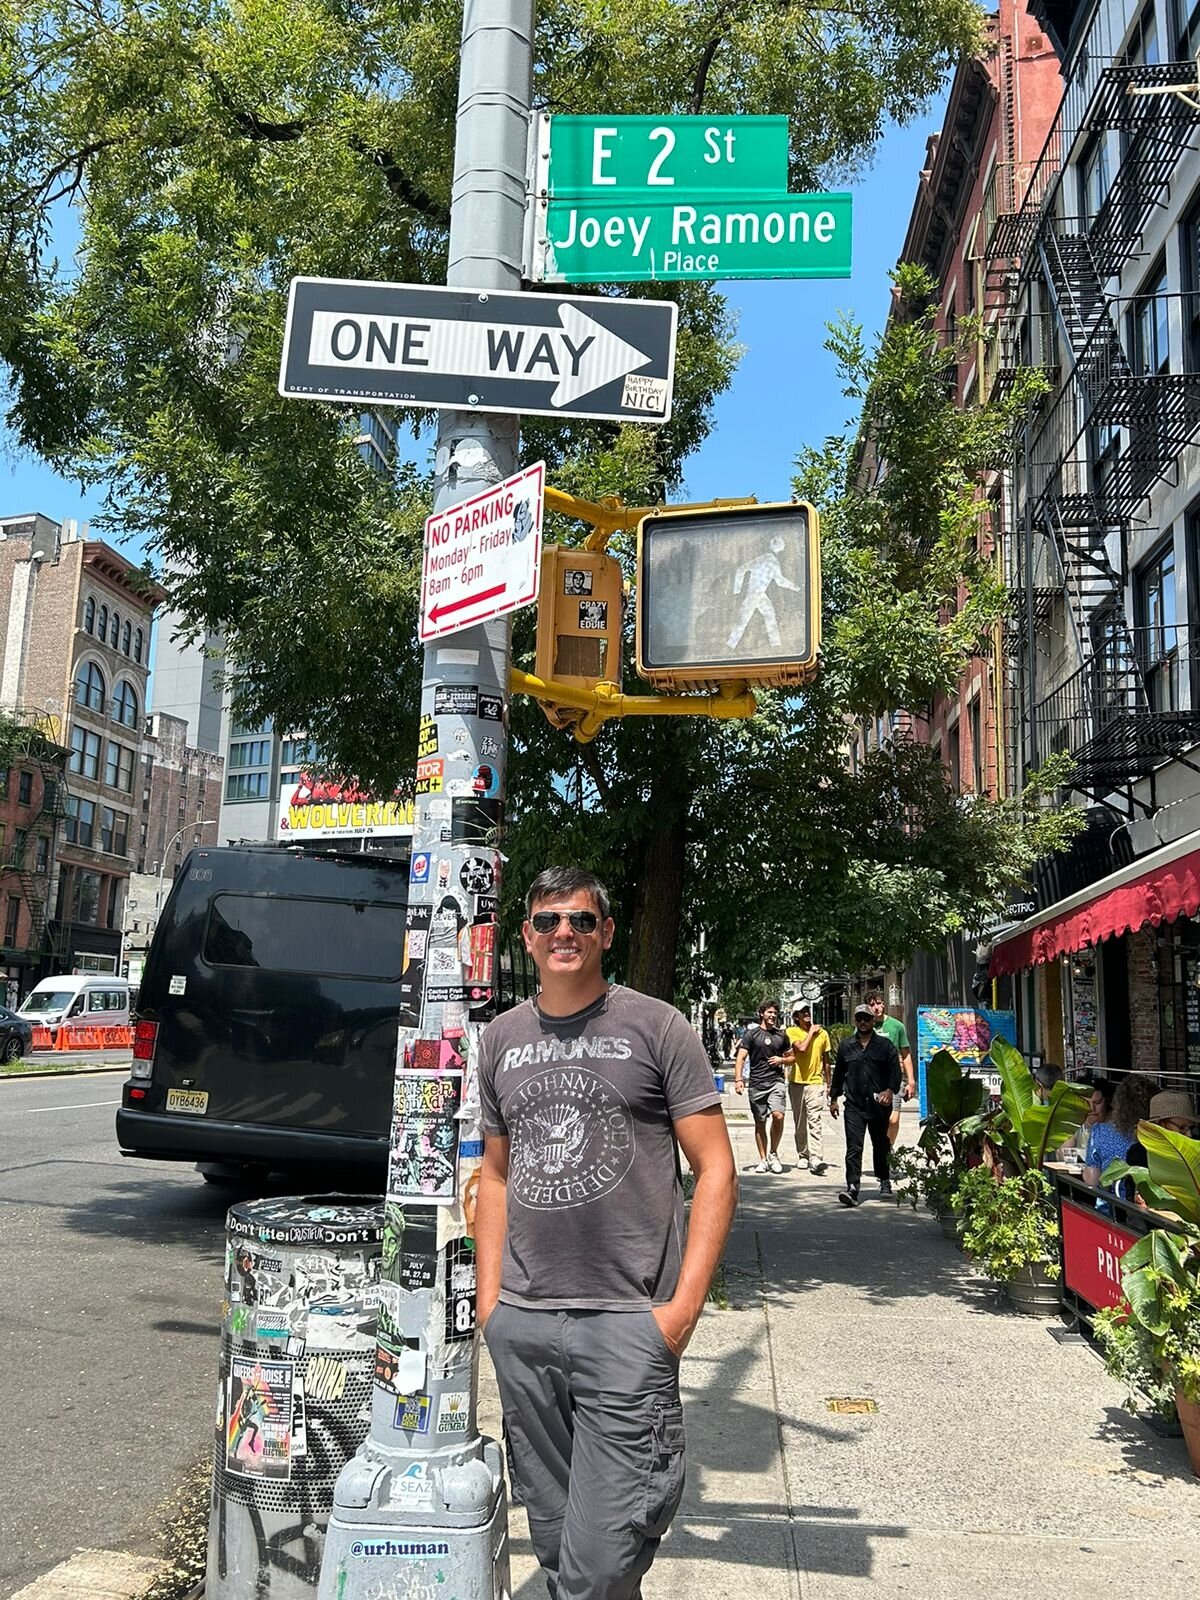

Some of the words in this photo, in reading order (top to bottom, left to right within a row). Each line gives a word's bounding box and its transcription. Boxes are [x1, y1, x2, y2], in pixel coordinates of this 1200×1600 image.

[592, 127, 618, 186] E
[647, 126, 676, 186] 2
[703, 126, 737, 163] St
[554, 209, 651, 256] Joey
[671, 205, 836, 245] Ramone
[664, 250, 719, 272] Place
[330, 319, 431, 366] ONE
[486, 328, 596, 377] WAY
[625, 384, 664, 397] BIRTHDAY
[627, 375, 654, 386] HAPPY
[290, 385, 314, 393] DEPT
[334, 388, 416, 400] TRANSPORTATION
[624, 393, 660, 410] NIC!
[431, 522, 450, 549] NO
[454, 492, 514, 540] PARKING
[430, 543, 469, 575] Monday
[480, 527, 512, 555] Friday
[429, 576, 451, 597] 8am
[461, 563, 483, 587] 6pm
[580, 601, 607, 610] CRAZY
[580, 620, 606, 629] EDDIE
[188, 868, 214, 881] 808
[503, 1036, 632, 1072] RAMONES
[519, 1072, 604, 1106] JOHNNY
[603, 1104, 631, 1157] JOEY
[528, 1163, 616, 1204] DEEDEE
[230, 1217, 255, 1235] Don't
[325, 1230, 369, 1242] Don't
[1108, 1233, 1124, 1250] BAR
[408, 1262, 424, 1270] JULY
[392, 1480, 398, 1490] 7
[350, 1541, 450, 1557] @urhuman
